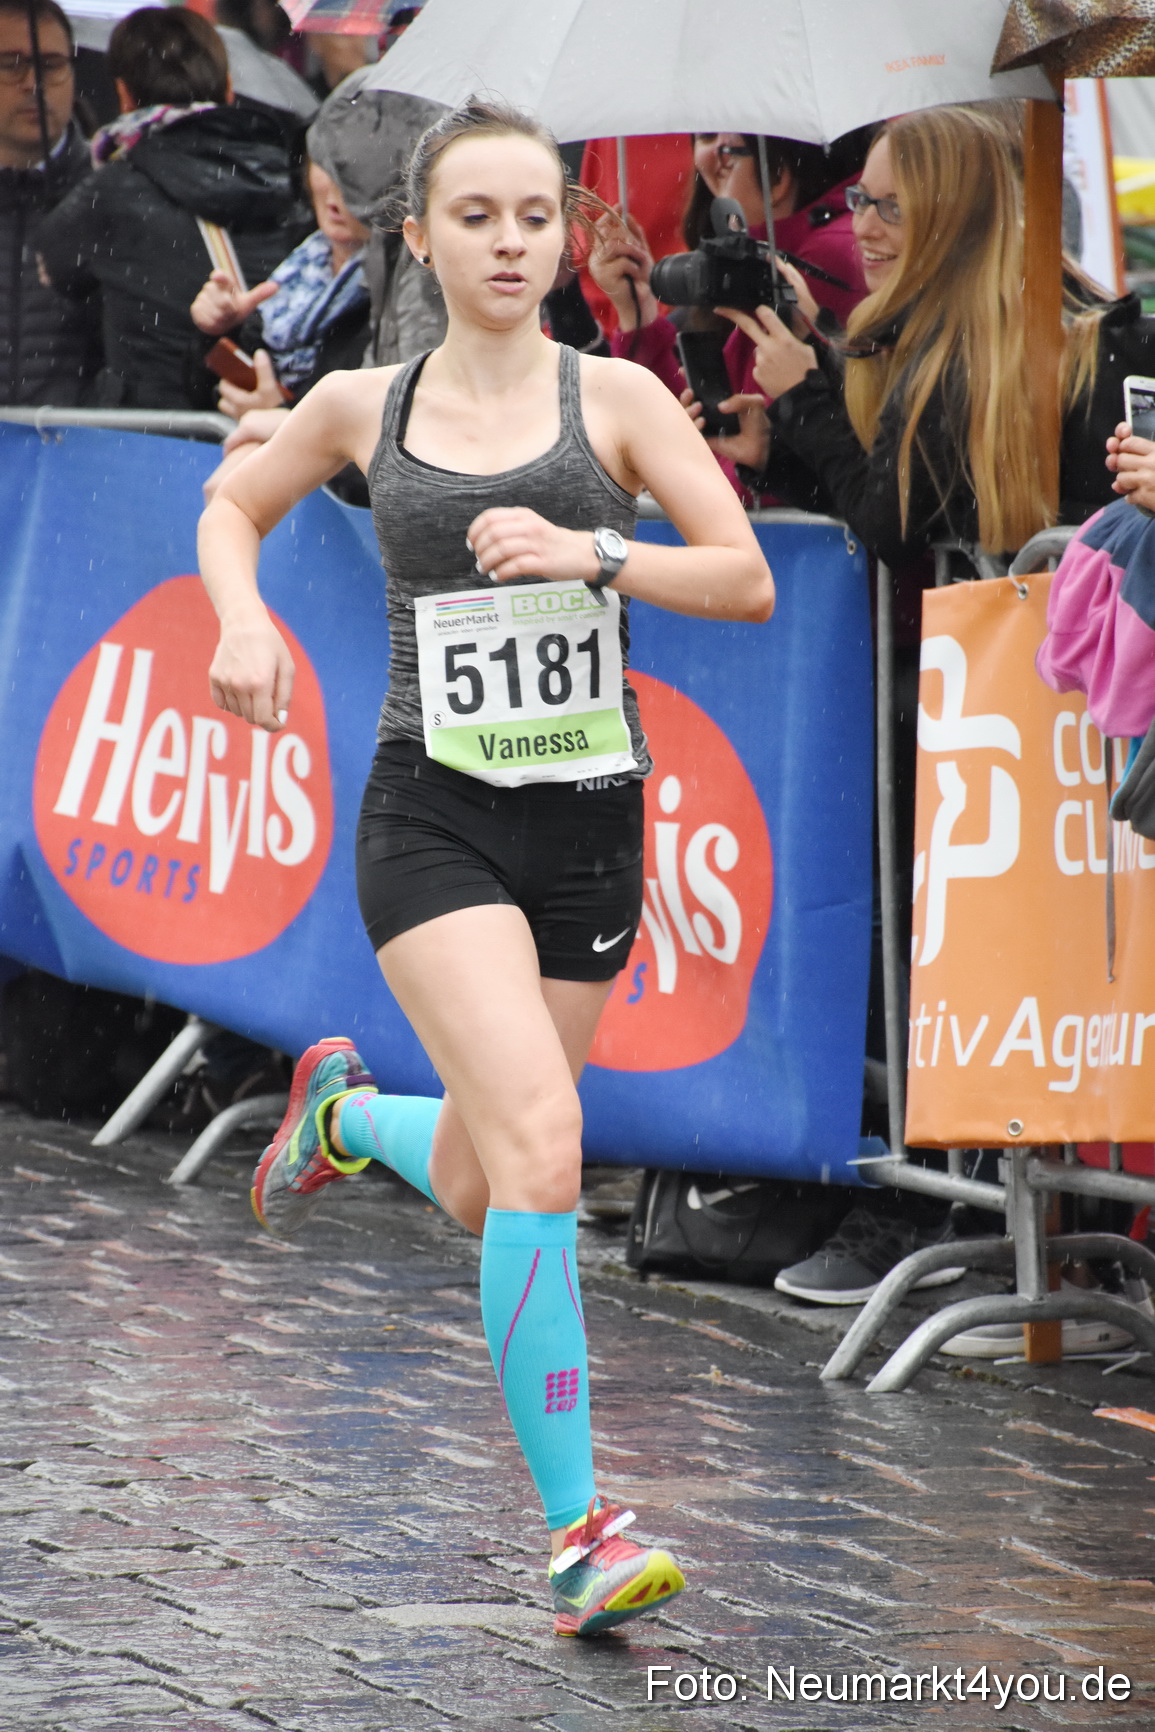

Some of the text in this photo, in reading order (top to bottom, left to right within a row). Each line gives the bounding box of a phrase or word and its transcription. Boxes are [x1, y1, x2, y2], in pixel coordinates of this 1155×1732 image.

[433, 612, 499, 629] NeuerMarkt
[444, 628, 601, 715] 5181
[433, 713, 442, 726] S
[478, 729, 590, 761] Vanessa
[52, 641, 316, 894] Hervis
[576, 776, 629, 792] NIK
[64, 838, 201, 904] SPORTS
[636, 775, 742, 995] vis
[908, 1000, 989, 1068] tiv
